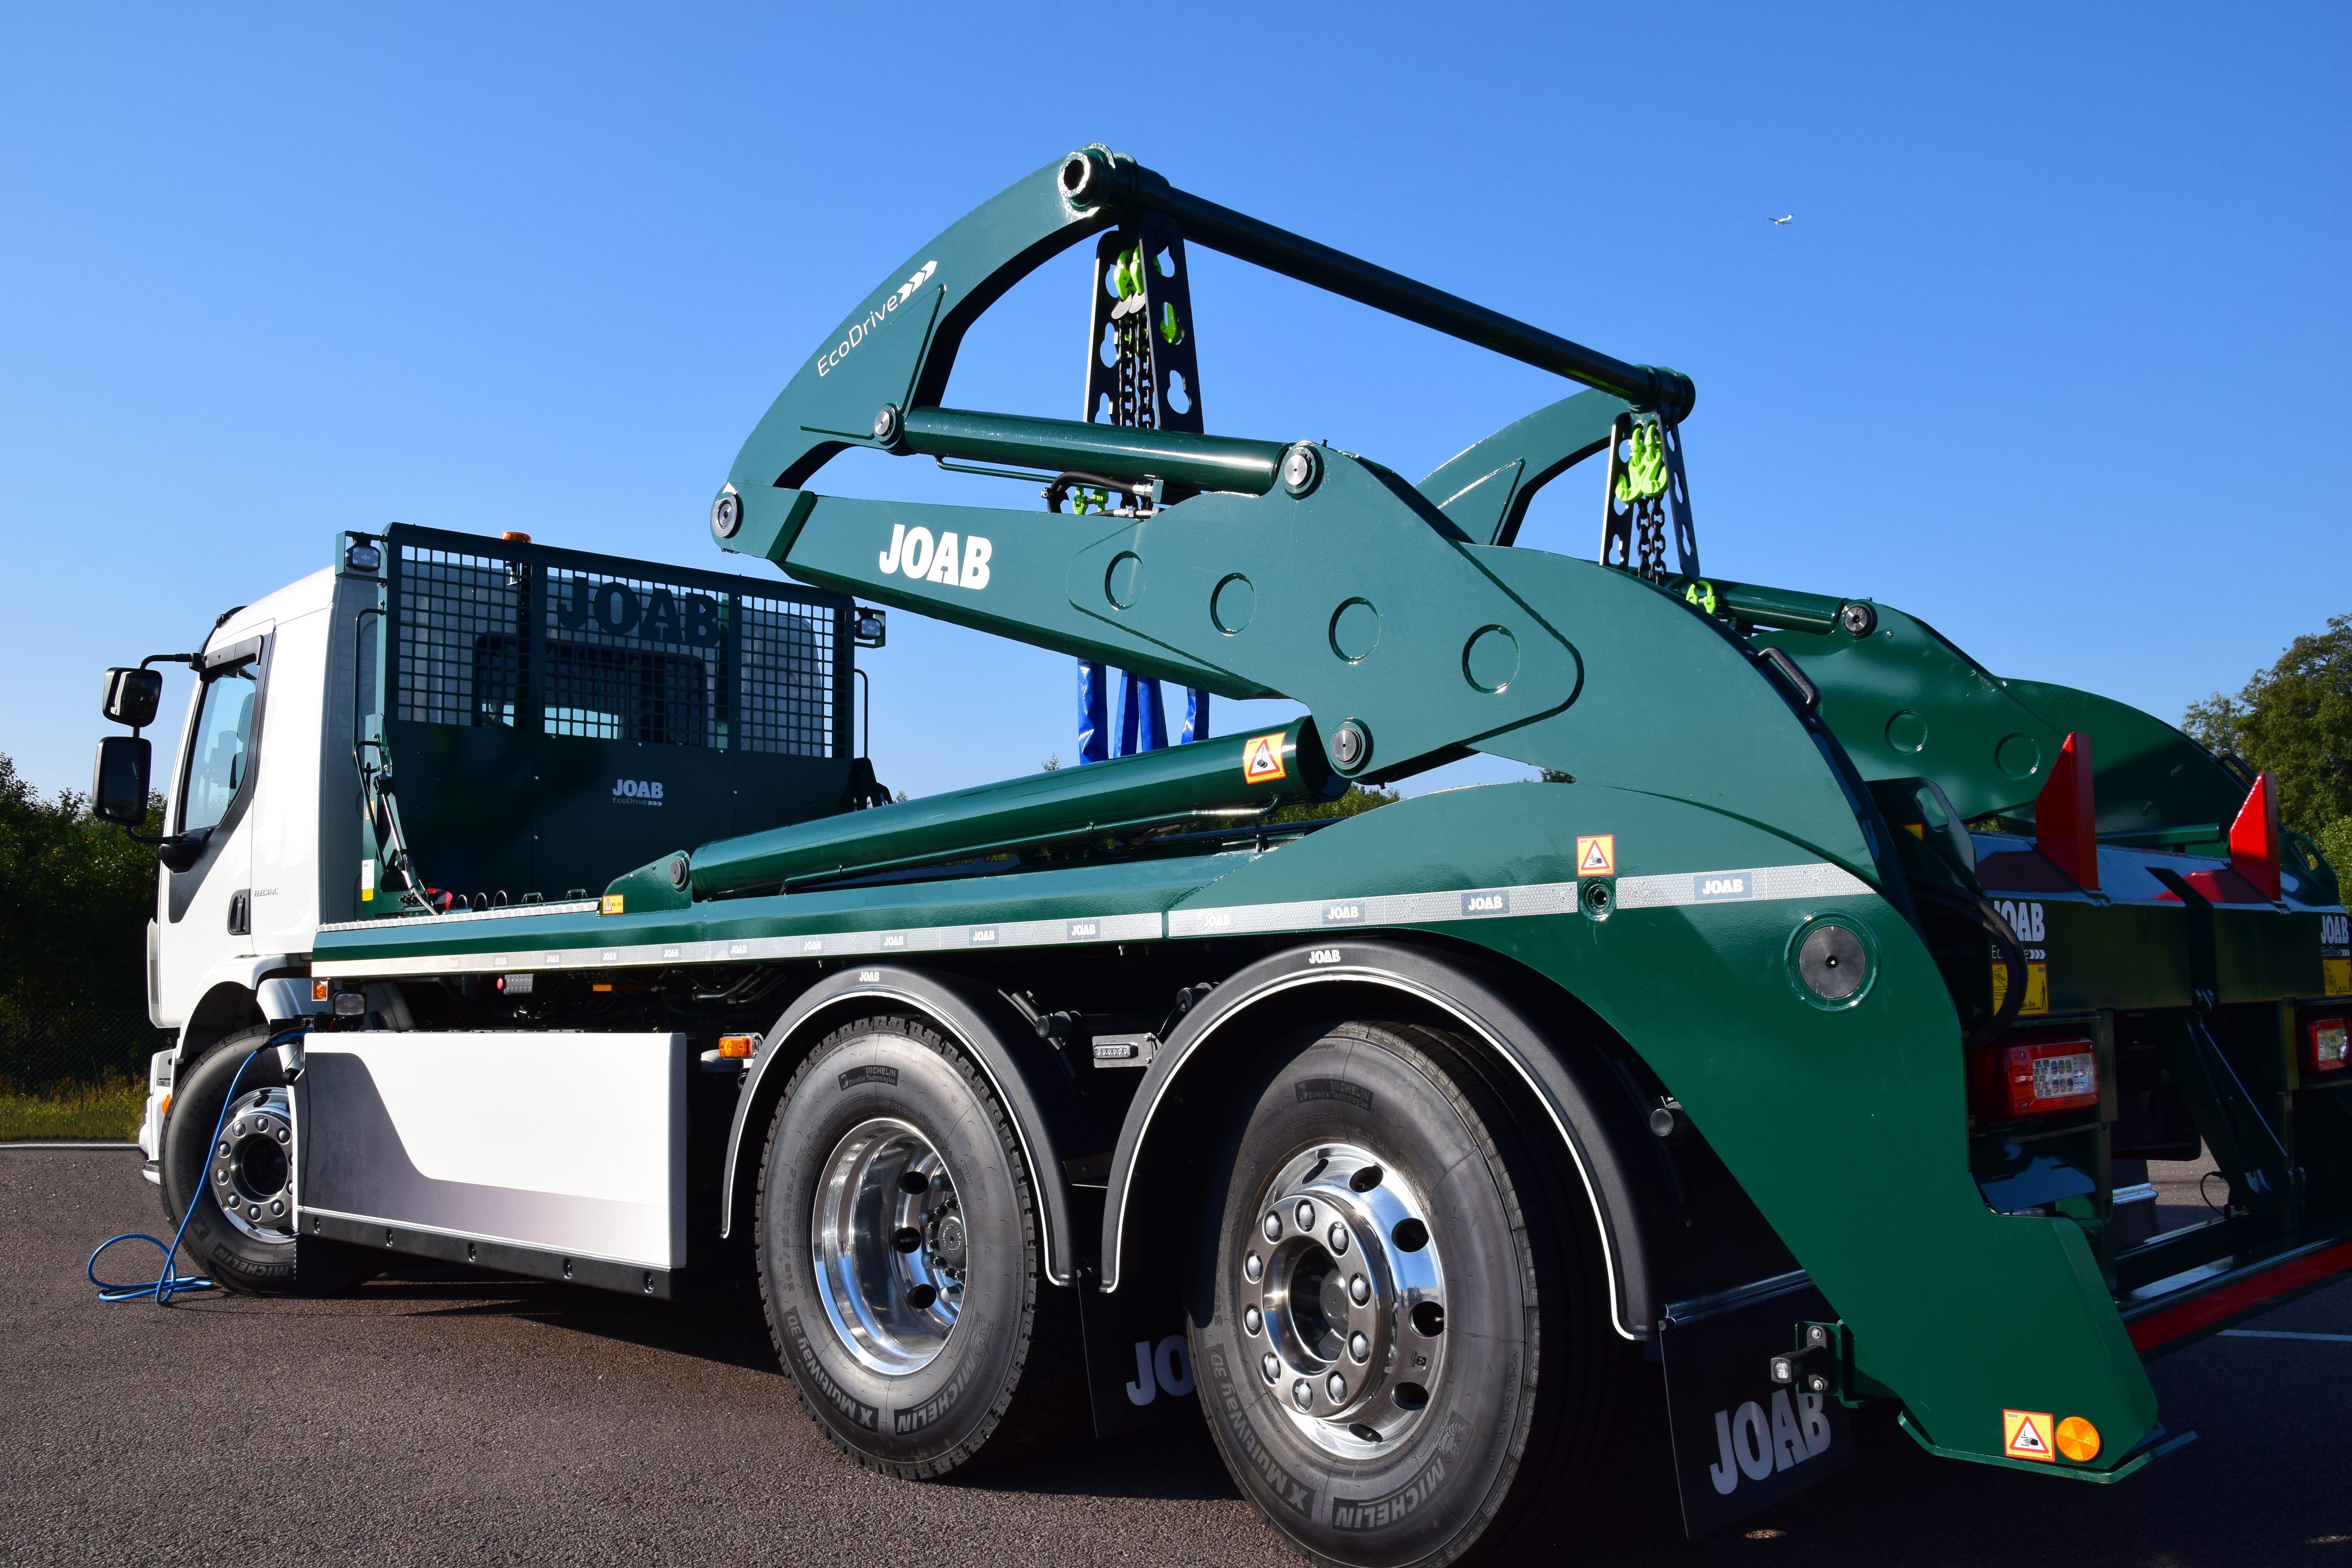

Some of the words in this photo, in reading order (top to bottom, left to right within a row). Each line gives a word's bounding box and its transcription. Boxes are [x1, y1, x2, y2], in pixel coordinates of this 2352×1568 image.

[818, 295, 898, 377] EcoDrive
[879, 524, 992, 590] JOAB
[556, 575, 720, 647] JOAB
[613, 779, 663, 799] JOAB
[1702, 879, 1744, 895] JOAB
[1328, 906, 1359, 919] JOAB
[1468, 896, 1503, 910] JOAB
[1072, 924, 1095, 936] JOAB
[1203, 915, 1230, 927] JOAB
[2321, 916, 2349, 944] JOAB
[804, 941, 821, 950] JOAB
[884, 936, 904, 946] JOAB
[973, 930, 995, 941] JOAB
[603, 952, 617, 960] JOAB
[664, 949, 679, 958] JOAB
[731, 945, 747, 954] JOAB
[1309, 950, 1340, 964] JOAB
[2322, 947, 2342, 956] EcoDrive
[859, 972, 879, 982] JOAB
[849, 1076, 866, 1085] Durable
[867, 1075, 896, 1084] Technologies
[866, 1067, 896, 1078] MICHELIN
[1330, 1081, 1370, 1101] MICHELIN
[785, 1167, 797, 1203] 22.5
[216, 1248, 289, 1277] MICHELIN
[788, 1314, 801, 1337] 3D
[1210, 1355, 1227, 1379] 3D
[1508, 1351, 1518, 1392] MICHELIN
[798, 1337, 857, 1419] MultiWay
[897, 1352, 977, 1433] MICHELIN
[859, 1407, 873, 1428] X
[1221, 1380, 1289, 1489] MultiWay
[1710, 1388, 1831, 1495] JOAB
[1287, 1487, 1309, 1514] X
[1335, 1458, 1447, 1528] MICHELIN
